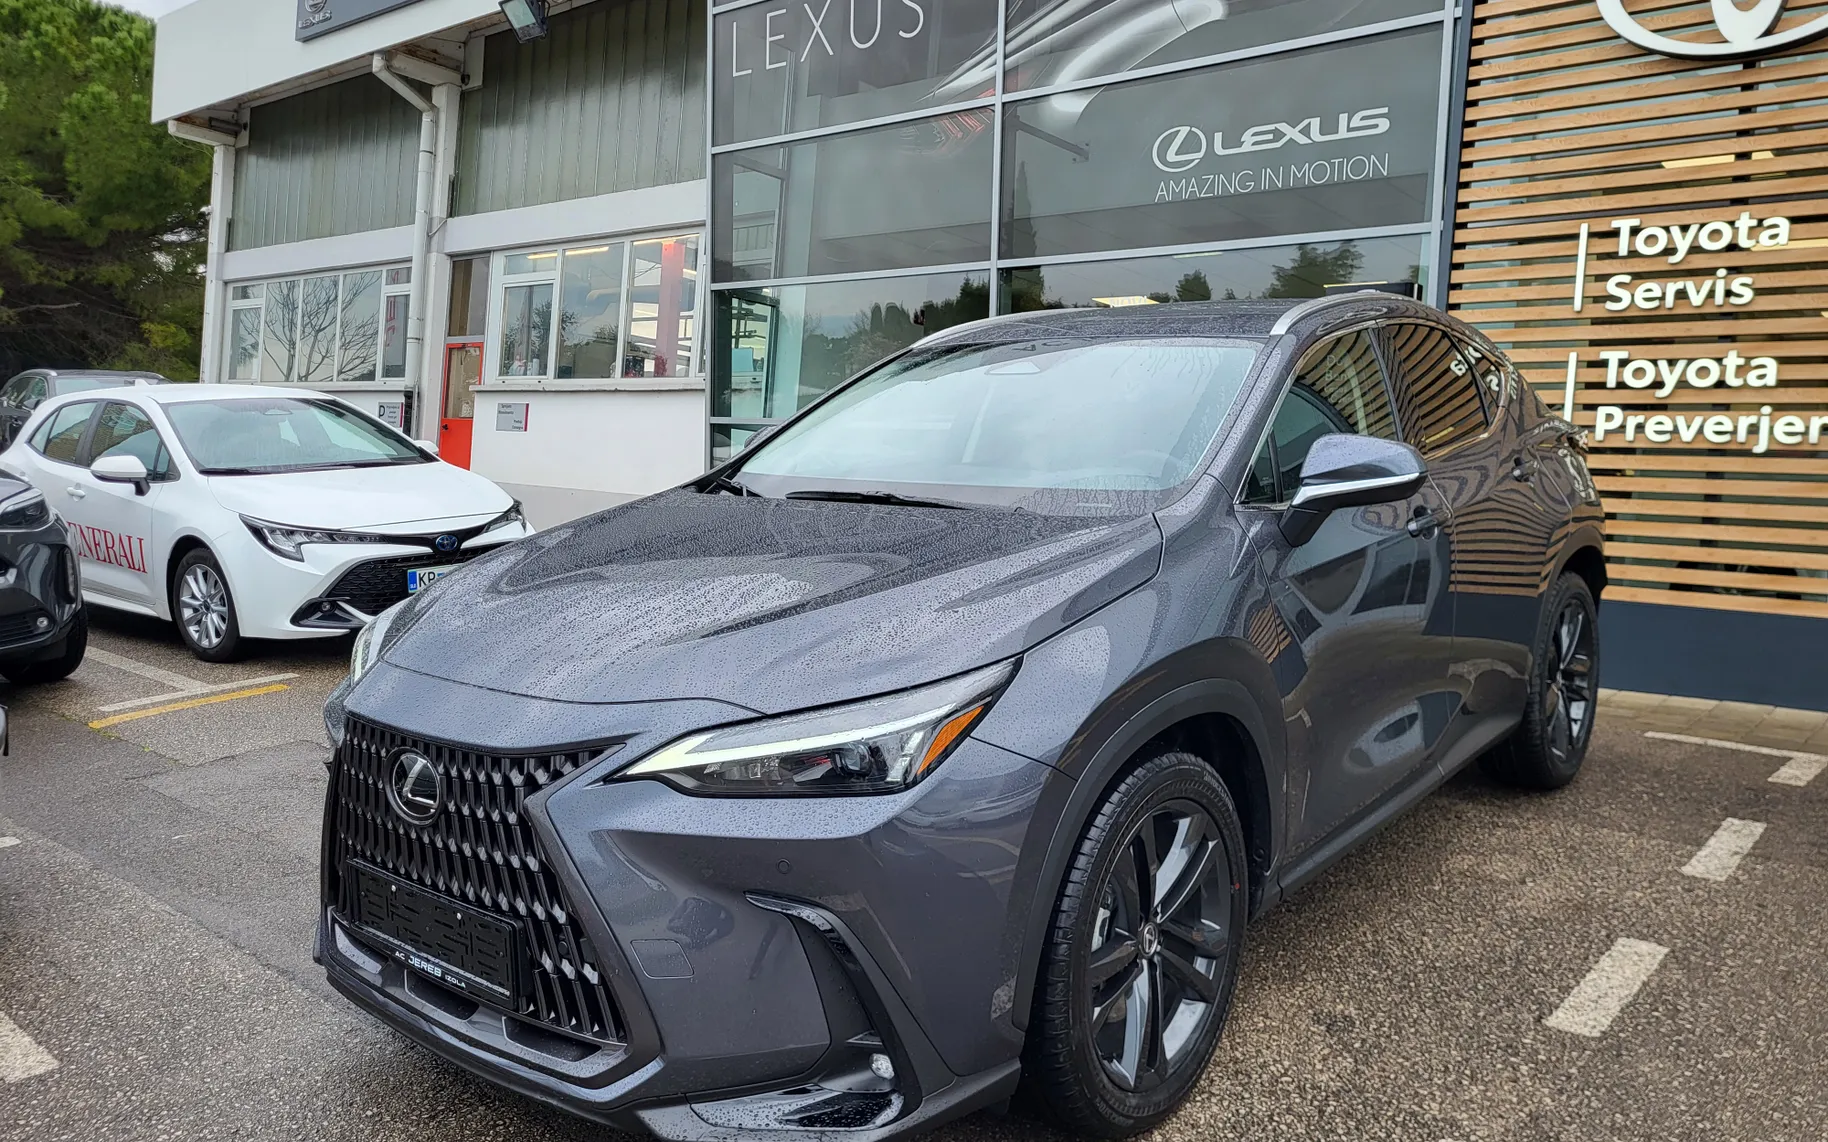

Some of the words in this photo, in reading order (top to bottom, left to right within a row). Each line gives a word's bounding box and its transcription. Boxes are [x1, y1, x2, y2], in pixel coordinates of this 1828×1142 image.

[732, 0, 925, 77] LEXUS
[1214, 106, 1391, 156] LEXUS
[1154, 170, 1255, 203] AMAZING
[1260, 165, 1283, 191] IN
[1290, 152, 1389, 187] MOTION
[1610, 211, 1791, 264] Toyota
[1604, 268, 1754, 311] Servis
[1599, 349, 1778, 398] Toyota
[408, 954, 442, 977] JEREB
[444, 974, 466, 988] IZOLA
